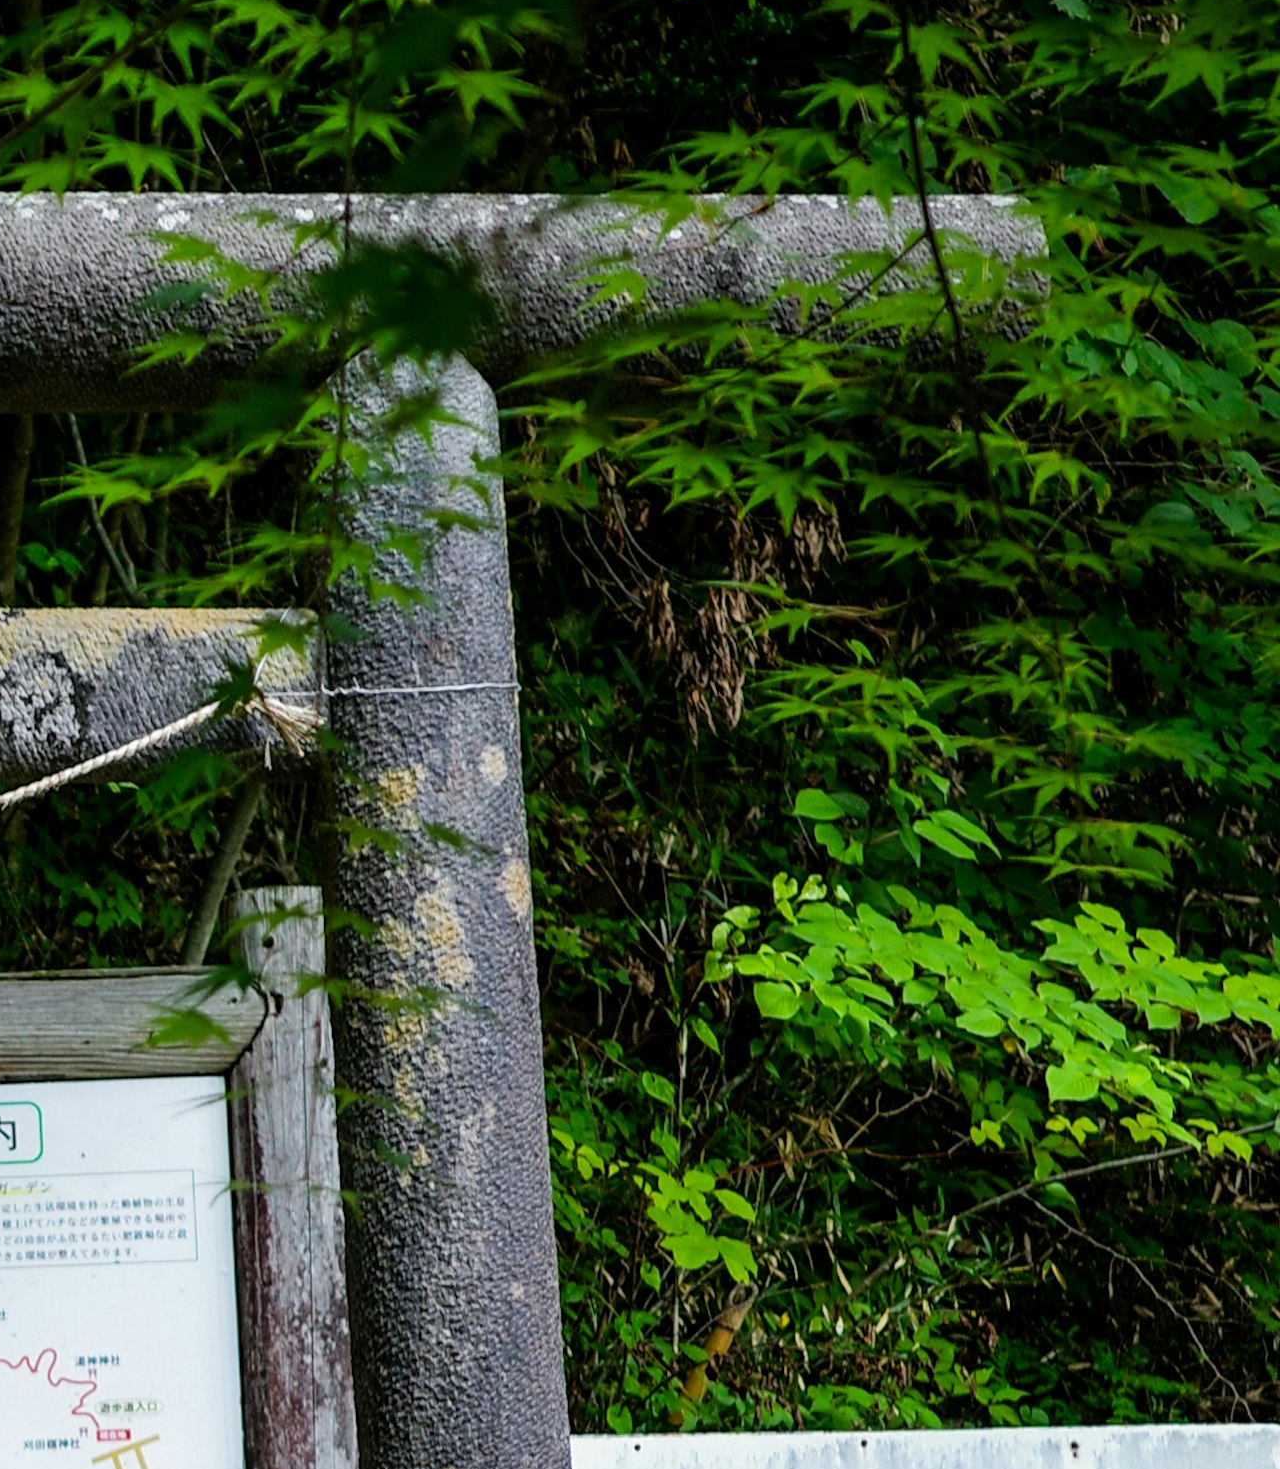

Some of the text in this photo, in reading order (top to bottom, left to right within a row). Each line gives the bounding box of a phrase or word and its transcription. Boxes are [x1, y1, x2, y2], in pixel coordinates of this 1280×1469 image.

[100, 1399, 158, 1414] 遊歩道入口
